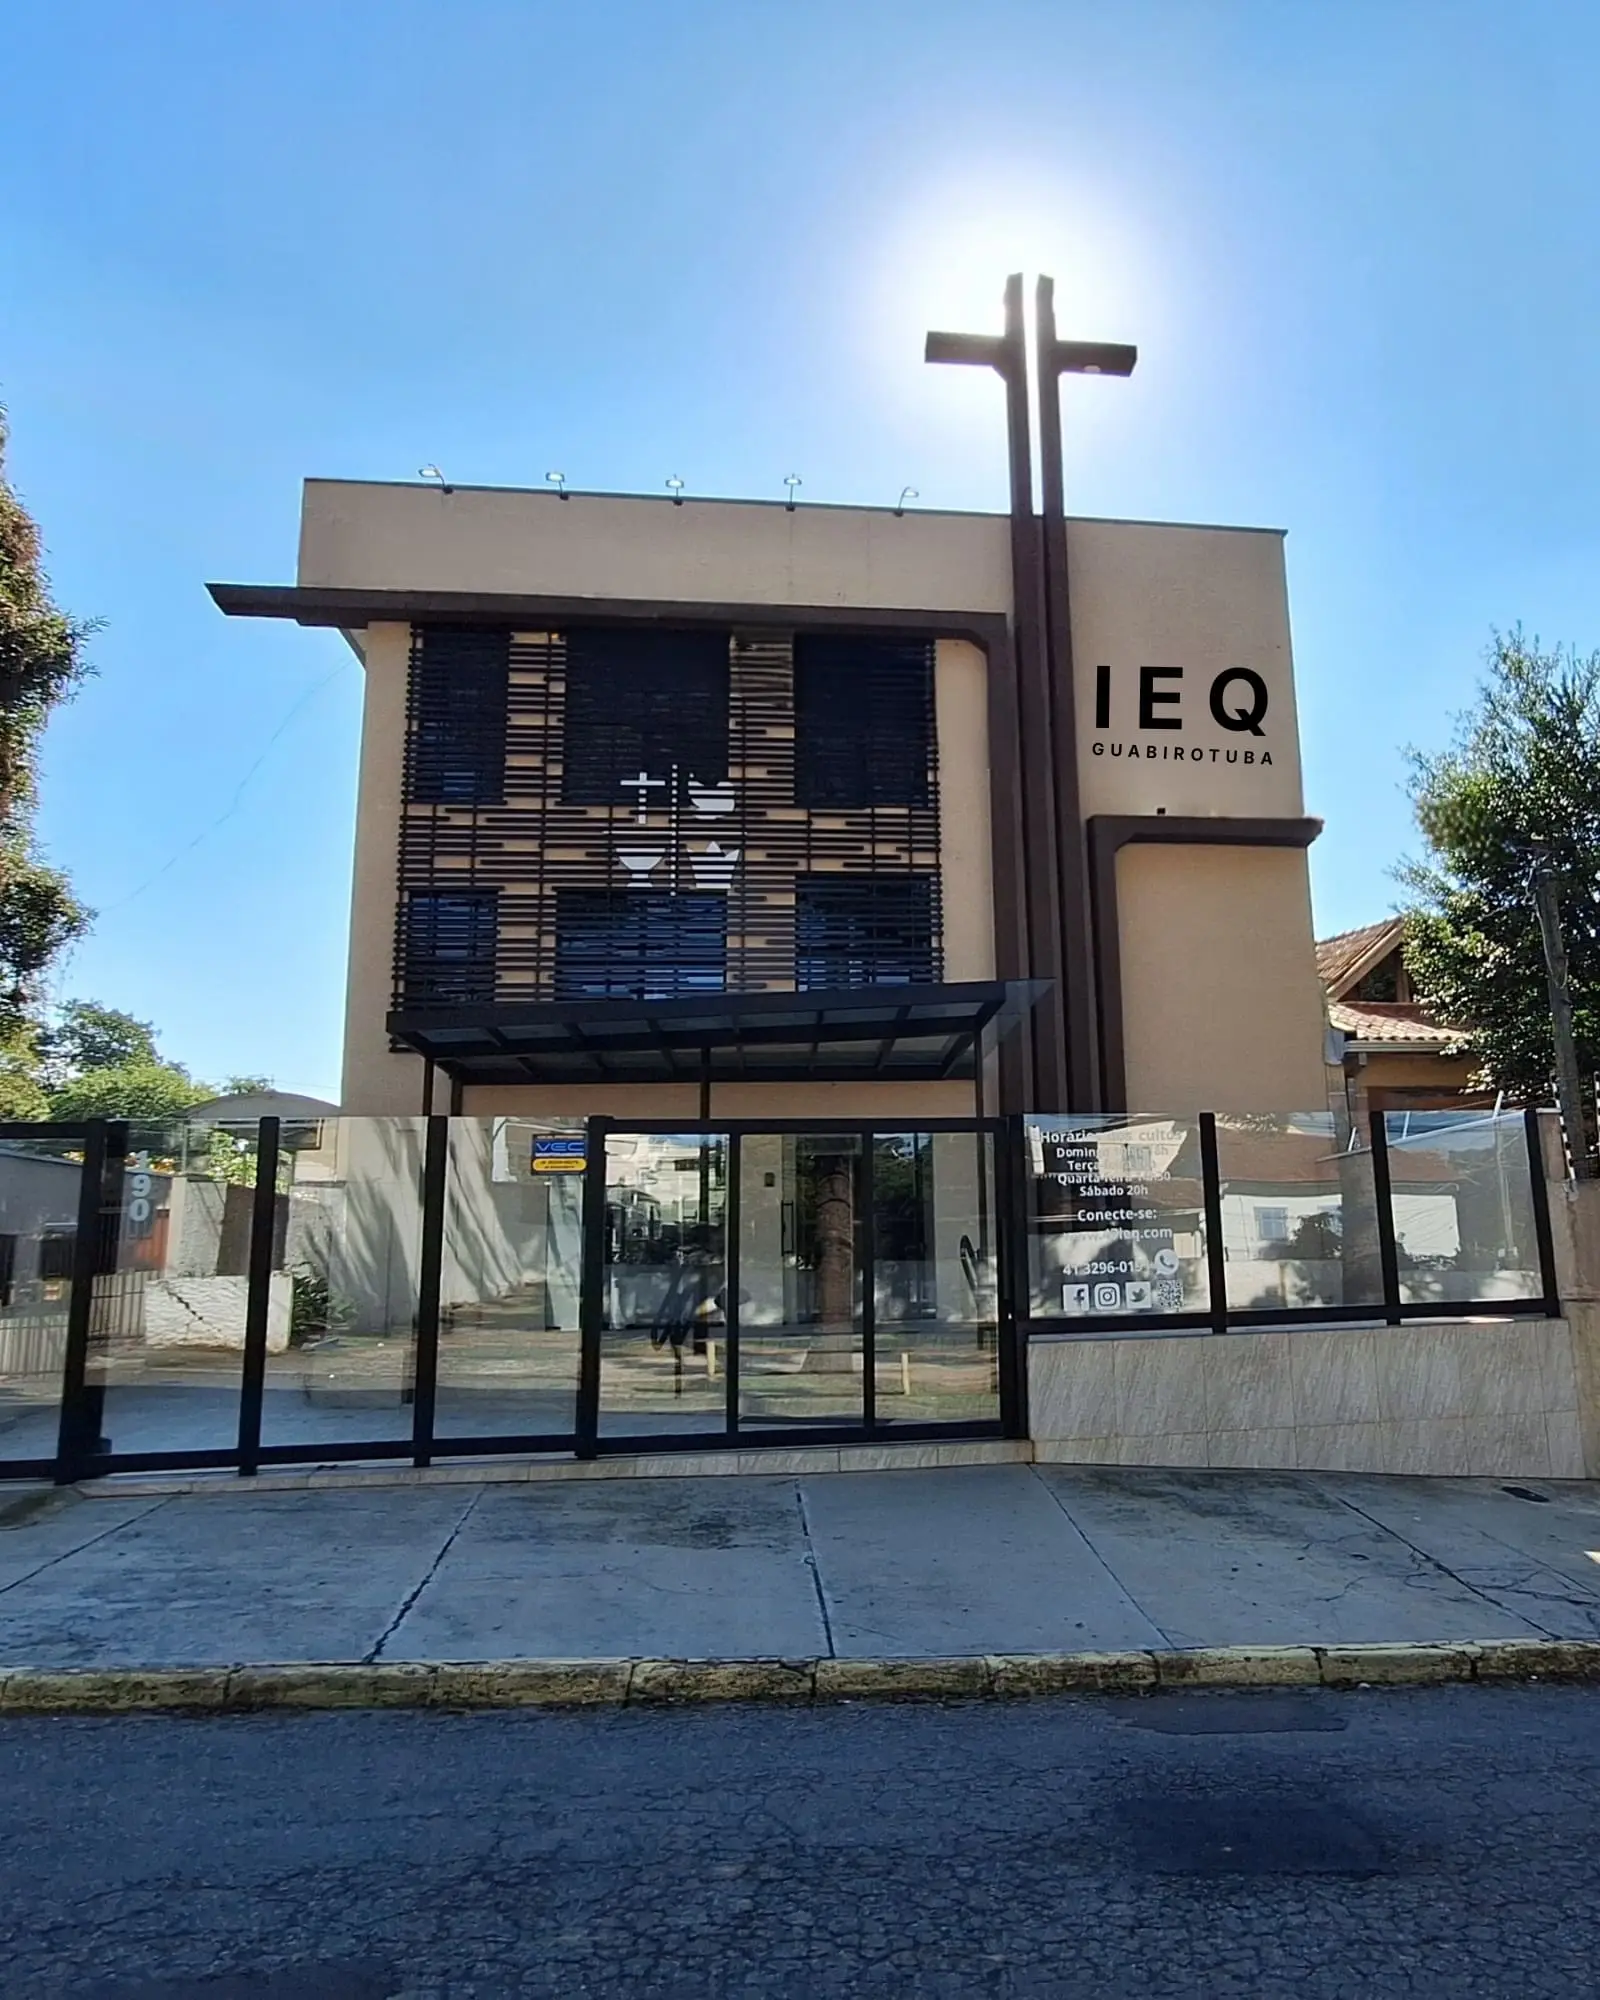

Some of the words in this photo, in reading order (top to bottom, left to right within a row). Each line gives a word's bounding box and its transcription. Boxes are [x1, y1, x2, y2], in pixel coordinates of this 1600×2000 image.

[1096, 666, 1268, 736] IEQ
[1092, 742, 1273, 765] GUABIROTUBA
[1079, 1184, 1124, 1197] Sábado
[1126, 1185, 1149, 1196] 20h
[1077, 1208, 1157, 1222] Conecte-se:
